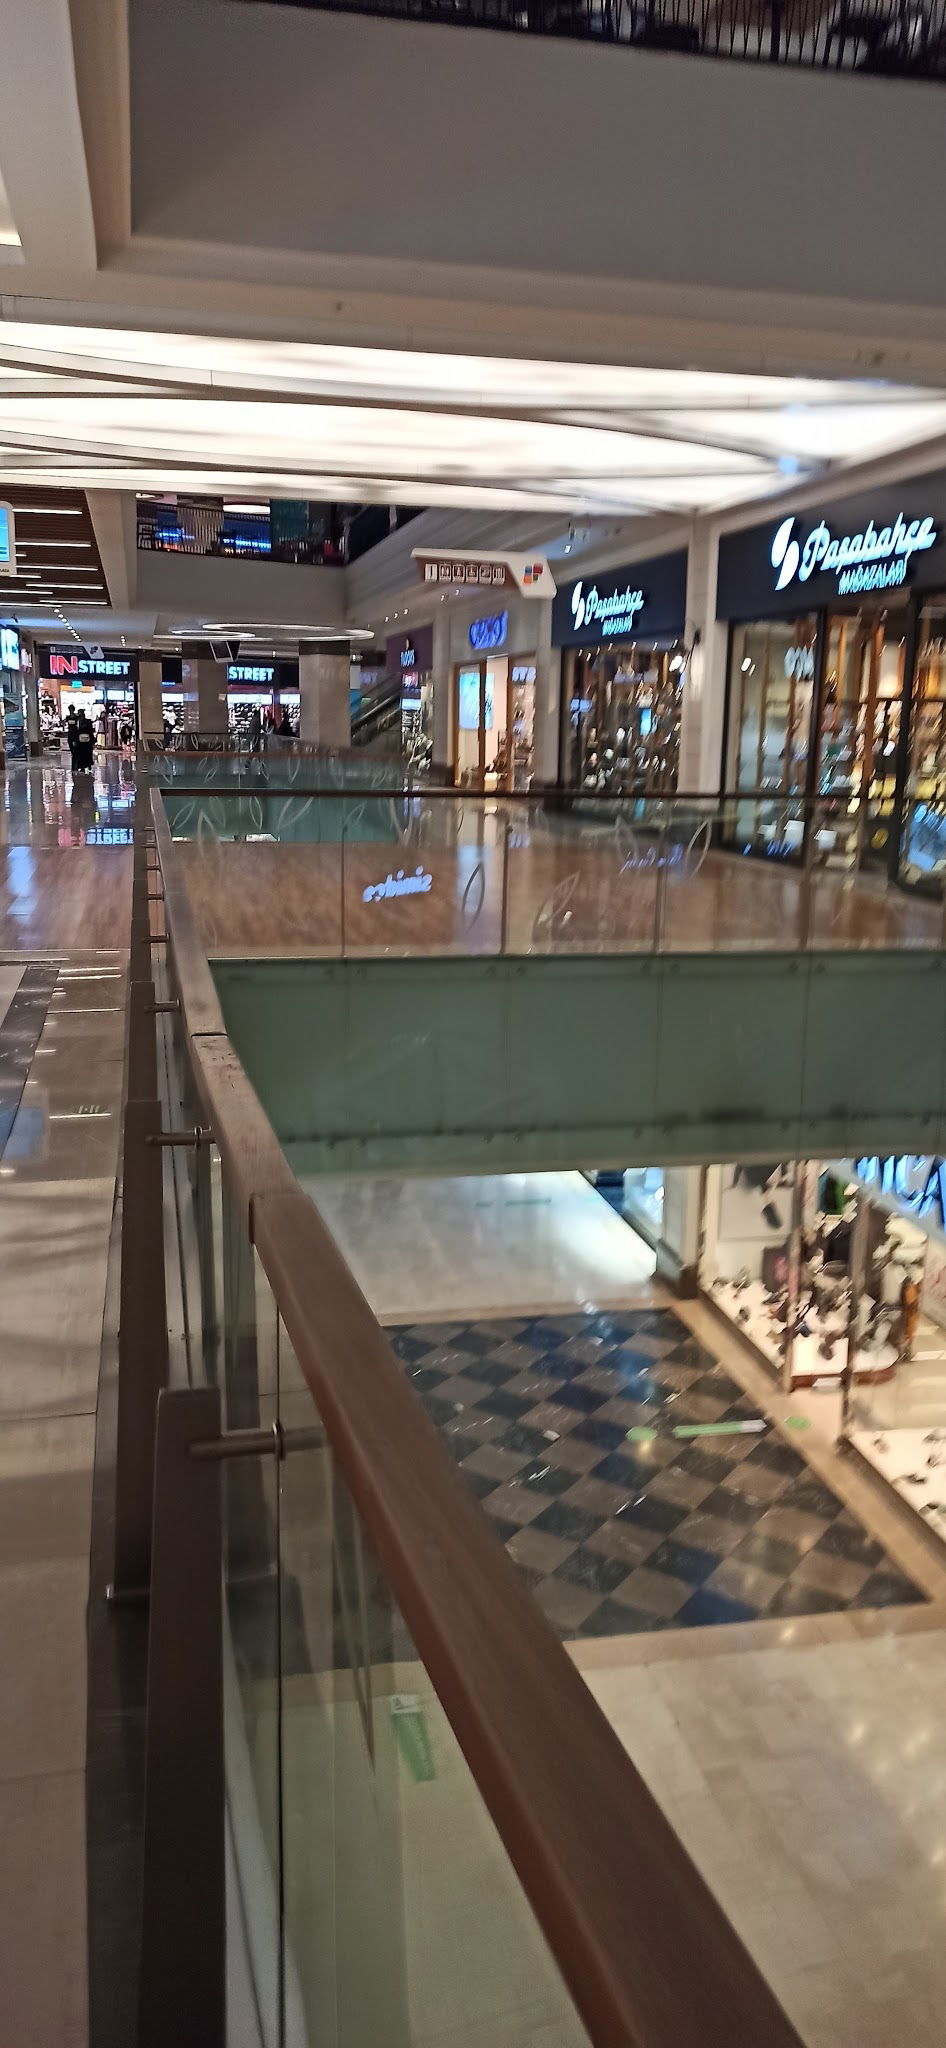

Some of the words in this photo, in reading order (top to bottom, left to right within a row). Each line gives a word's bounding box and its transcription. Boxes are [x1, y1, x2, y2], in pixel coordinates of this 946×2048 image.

[798, 511, 937, 582] Paşabahçe
[78, 661, 131, 675] STREET
[228, 666, 275, 681] STREET
